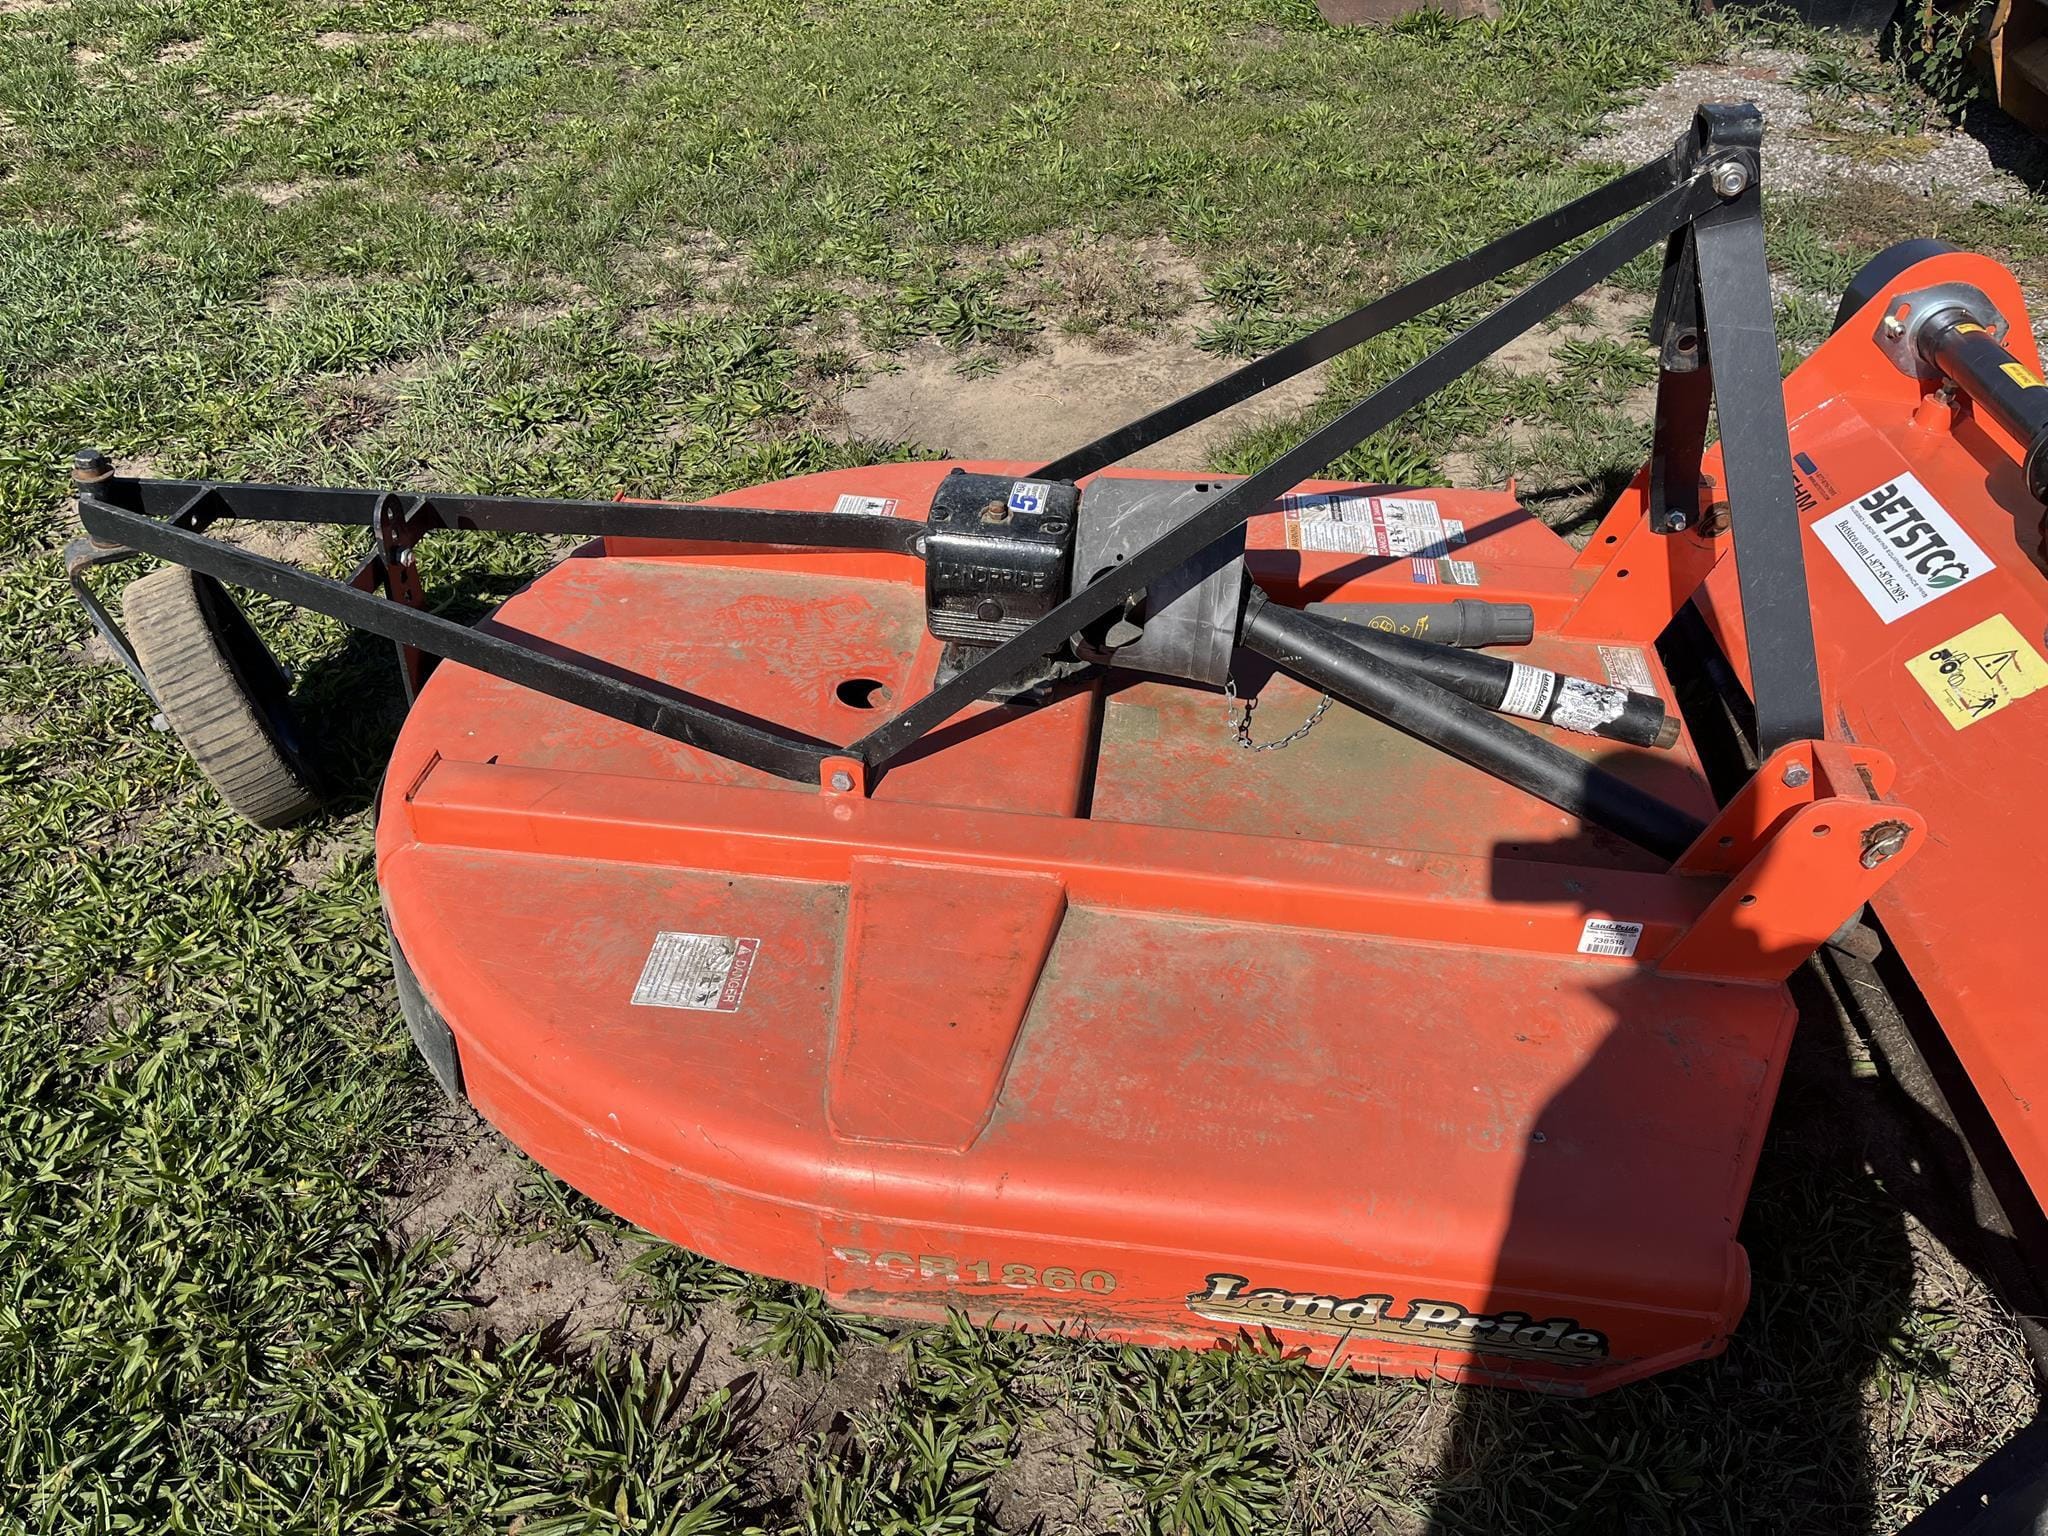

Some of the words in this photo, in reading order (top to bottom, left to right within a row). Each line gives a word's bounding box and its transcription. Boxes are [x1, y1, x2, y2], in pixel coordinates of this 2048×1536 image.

[1011, 494, 1038, 511] 5
[1837, 519, 1869, 557] Betstco.com
[1865, 553, 1910, 602] 1-877-876-7895
[1588, 921, 1614, 931] Land
[723, 959, 746, 1003] DANGER
[1202, 1271, 1395, 1326] Land
[1399, 1298, 1608, 1355] Pride
